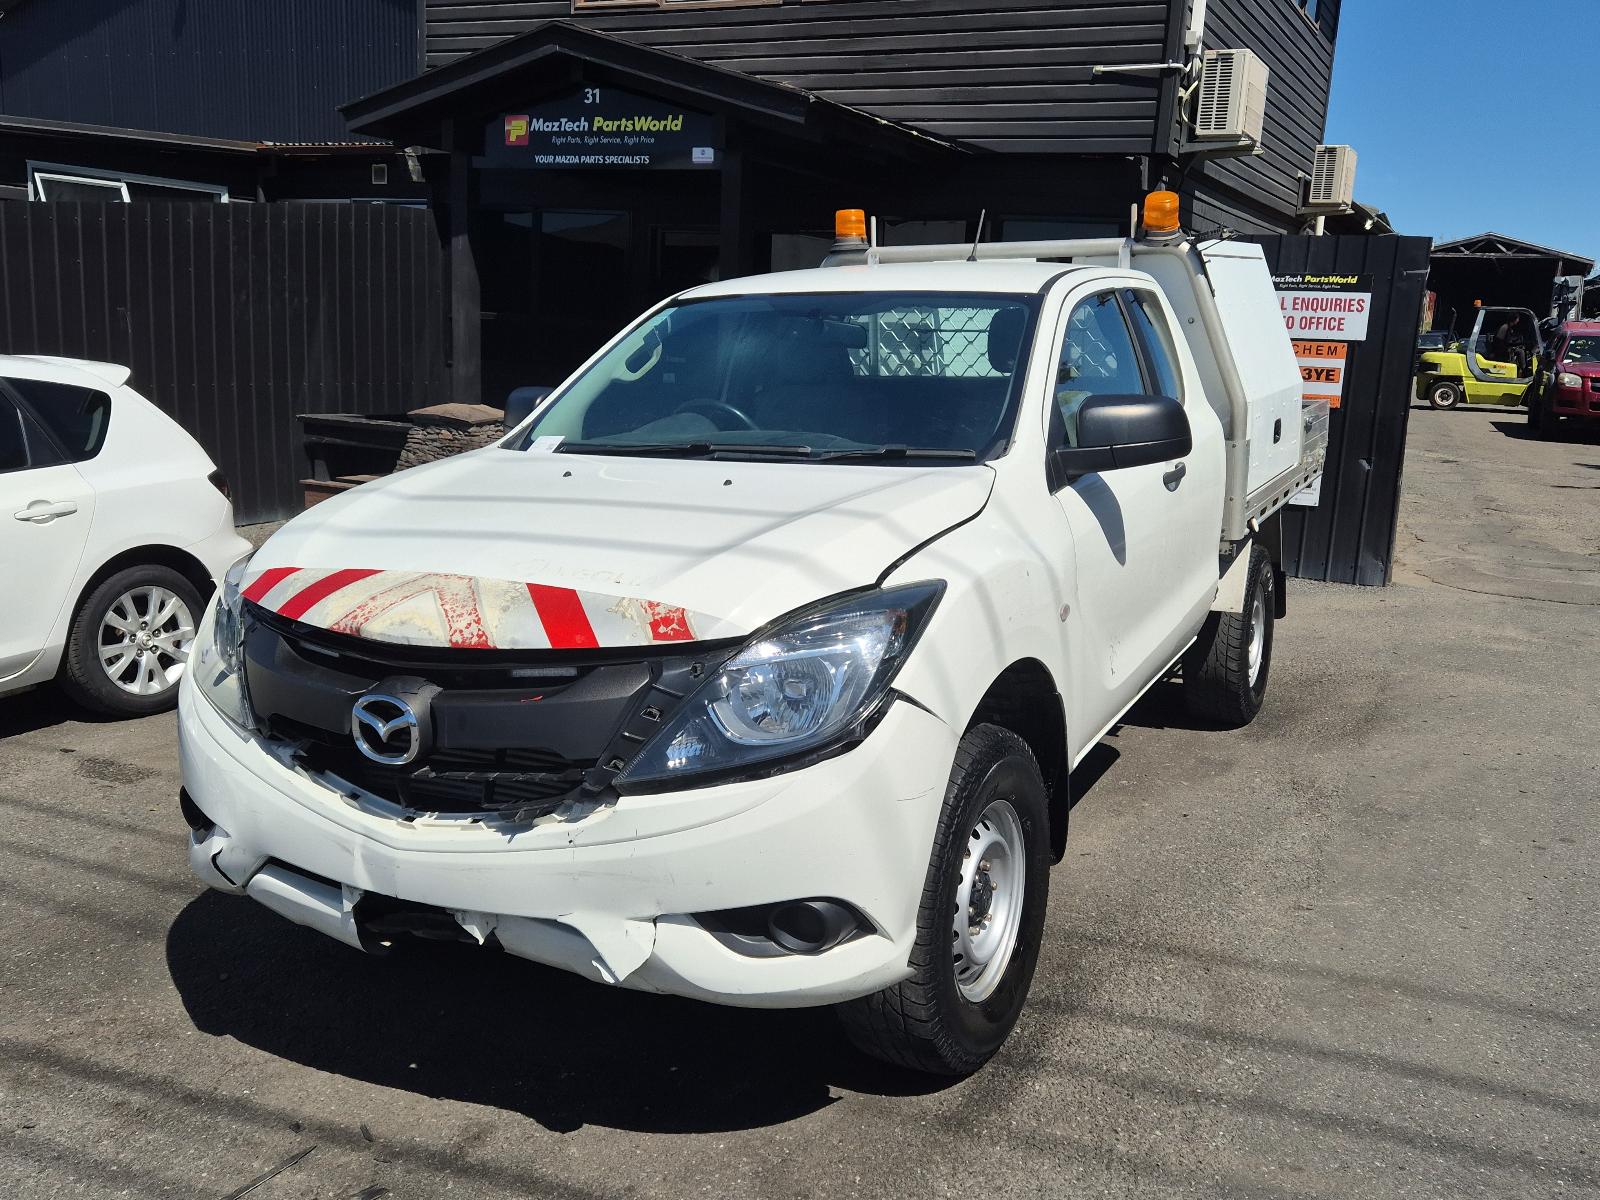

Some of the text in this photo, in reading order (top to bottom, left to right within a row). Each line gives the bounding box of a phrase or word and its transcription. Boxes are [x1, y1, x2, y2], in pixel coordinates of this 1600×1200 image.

[584, 88, 600, 104] 31
[530, 115, 683, 132] MazTech PartsWorld
[551, 136, 655, 146] Right Parts, Right Service, Right Price
[534, 155, 650, 164] YOUR MAZDA PARTS SPECIALISTS
[1304, 275, 1358, 284] PartsWorld
[1292, 297, 1366, 313] ENQUIRIES
[1299, 316, 1345, 331] OFFICE
